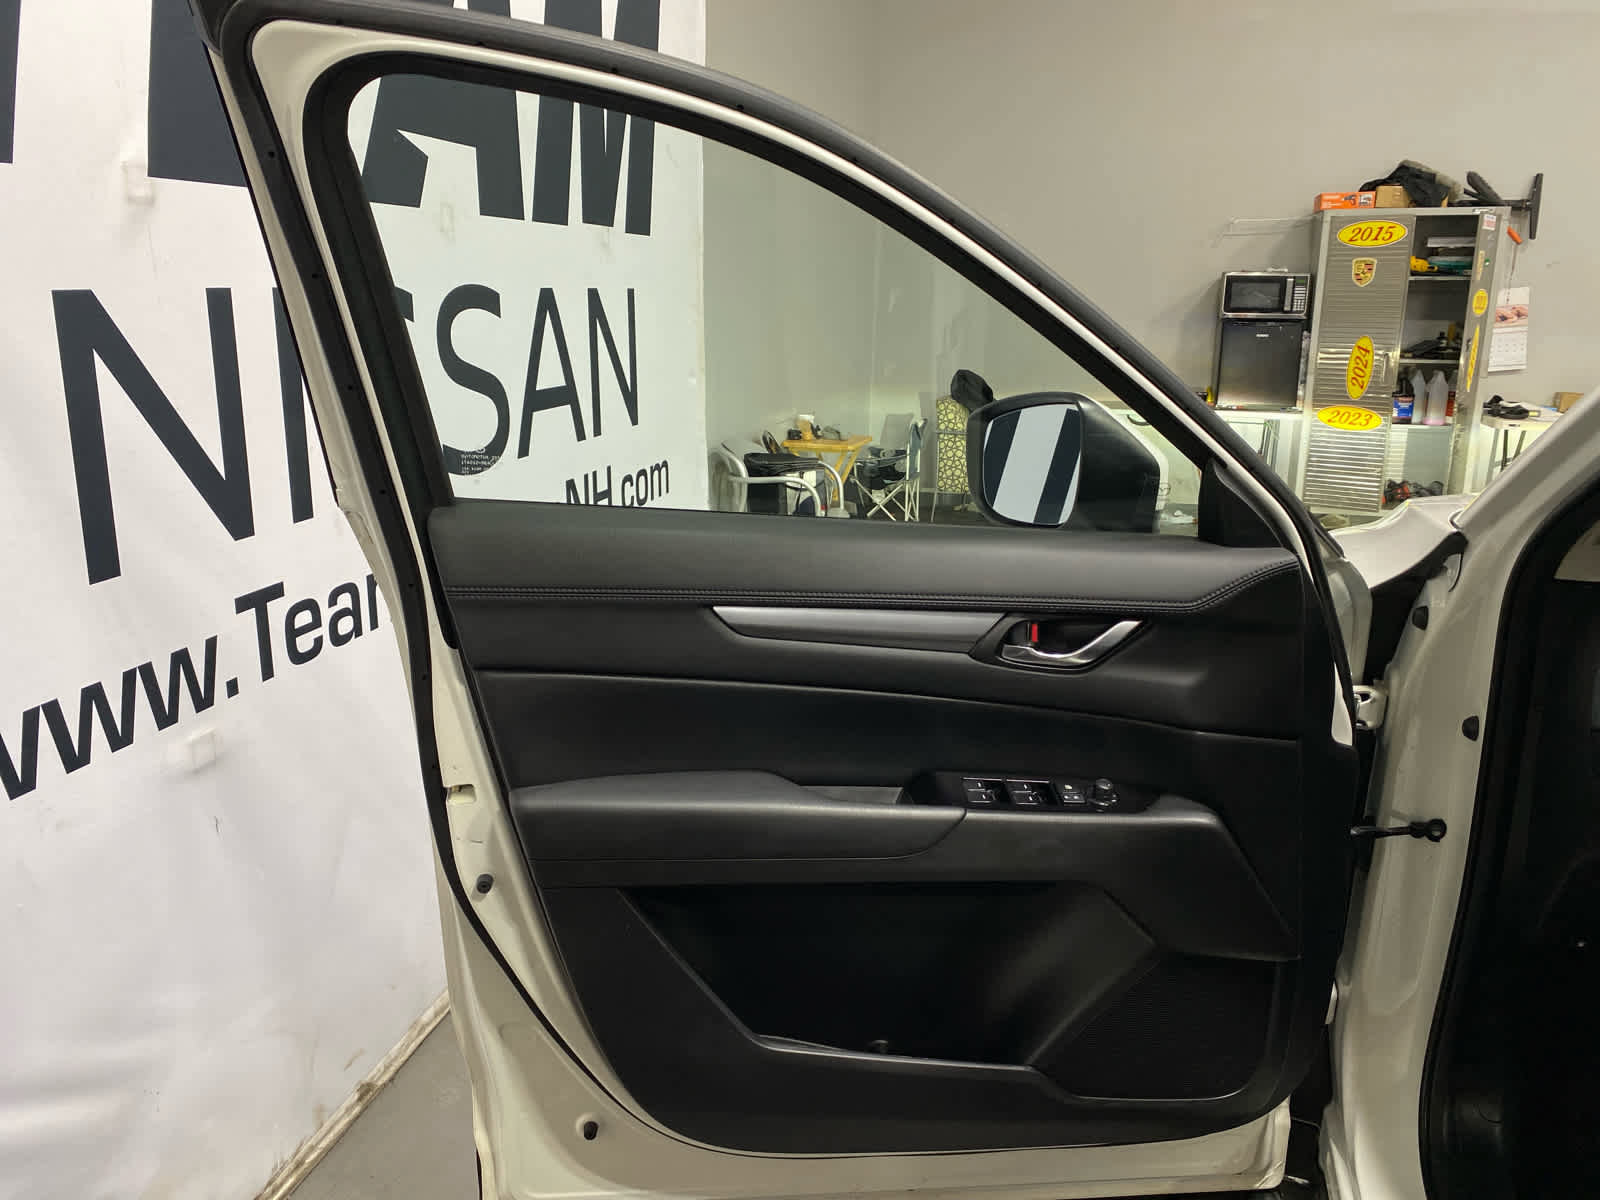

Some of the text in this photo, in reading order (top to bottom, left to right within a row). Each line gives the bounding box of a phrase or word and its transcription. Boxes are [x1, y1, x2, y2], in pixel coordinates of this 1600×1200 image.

[1348, 225, 1397, 242] 2015
[1350, 345, 1371, 390] 2024
[52, 283, 639, 585] NISAN
[1327, 409, 1373, 428] 2023
[0, 573, 383, 801] ww.Tea
